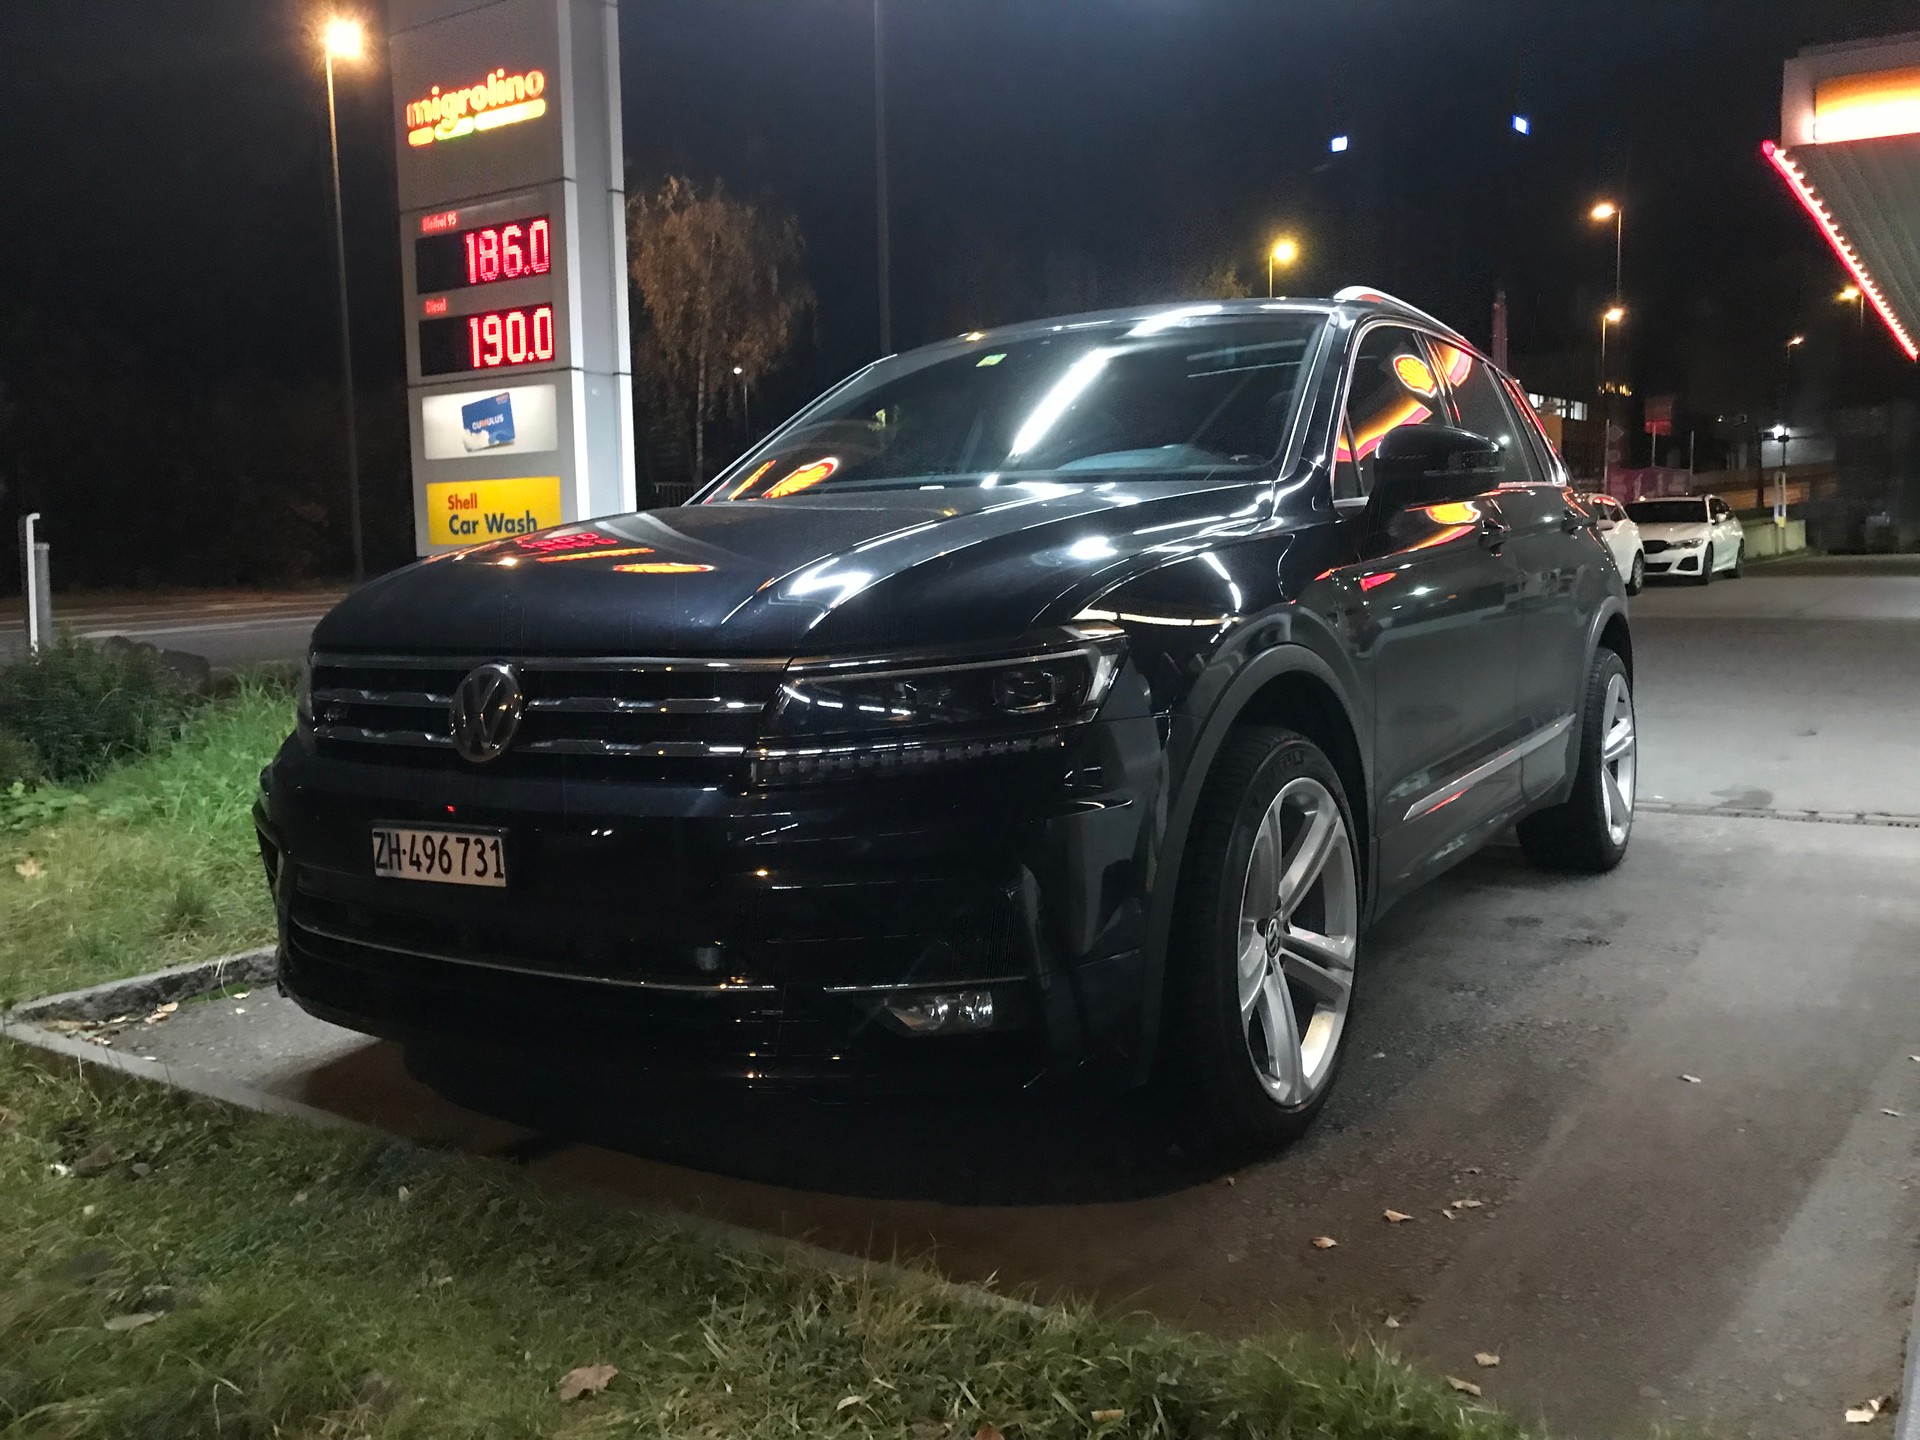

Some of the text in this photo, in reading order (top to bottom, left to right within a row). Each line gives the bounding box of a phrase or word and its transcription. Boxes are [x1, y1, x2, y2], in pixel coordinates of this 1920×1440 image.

[406, 68, 545, 130] migrolino
[447, 212, 457, 226] 95
[464, 219, 550, 284] 186.0
[468, 307, 554, 368] 190.0
[447, 493, 478, 510] Shell
[448, 510, 538, 535] Car Wash
